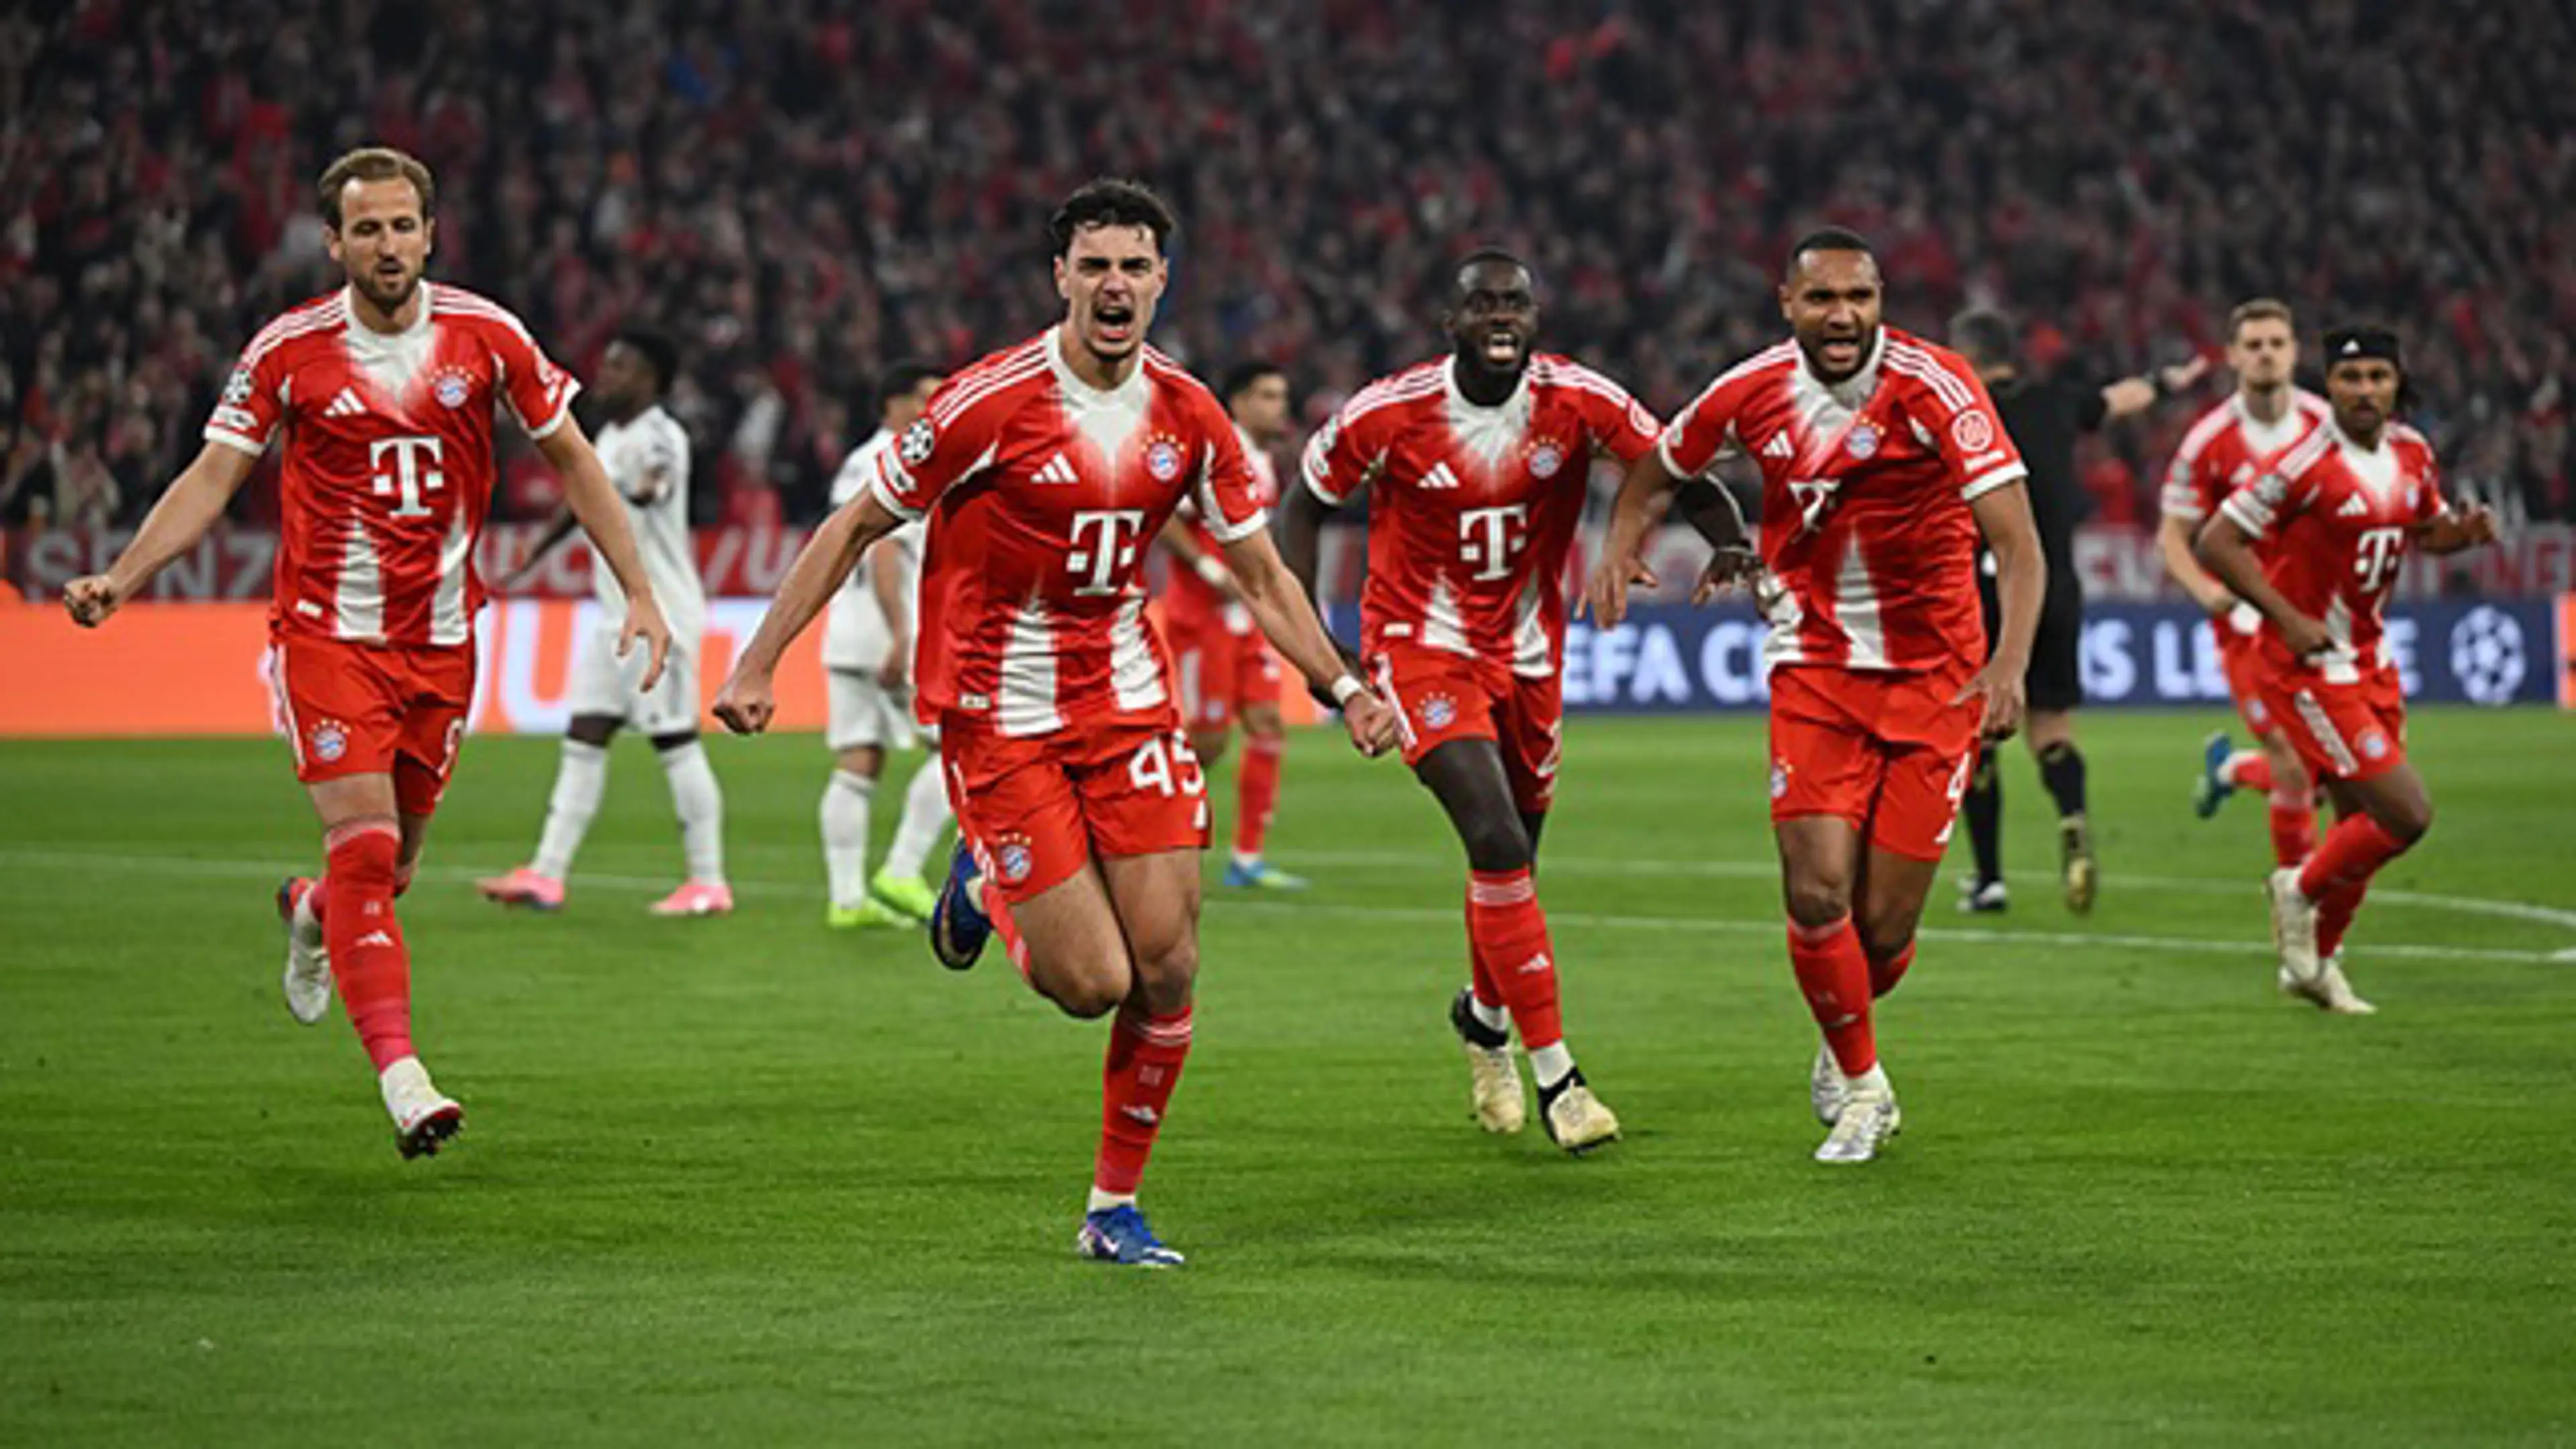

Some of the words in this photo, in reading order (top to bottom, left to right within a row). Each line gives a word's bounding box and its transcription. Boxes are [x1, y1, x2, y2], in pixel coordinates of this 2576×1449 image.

[371, 437, 443, 516] T
[1067, 510, 1144, 596] T
[1460, 504, 1526, 581] T
[2355, 527, 2403, 592] T
[1562, 623, 1692, 703] EFA
[1129, 728, 1205, 796] 45
